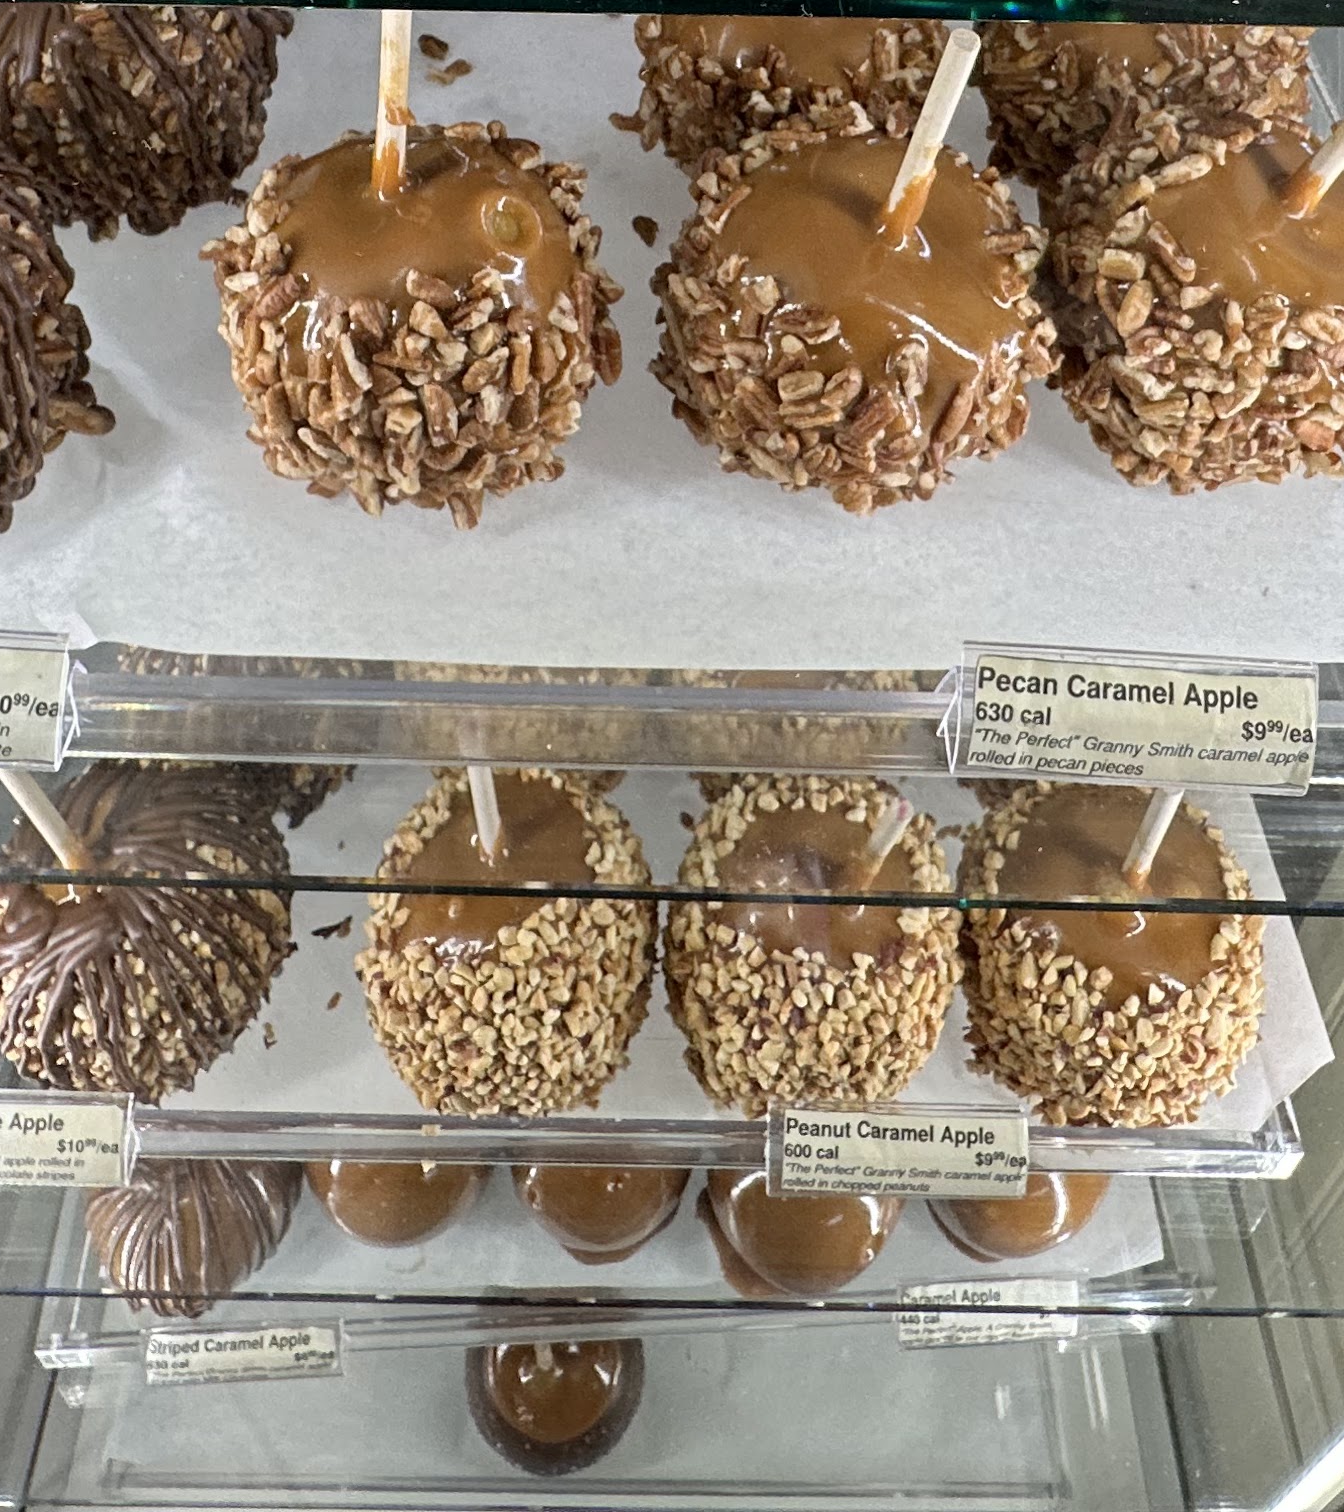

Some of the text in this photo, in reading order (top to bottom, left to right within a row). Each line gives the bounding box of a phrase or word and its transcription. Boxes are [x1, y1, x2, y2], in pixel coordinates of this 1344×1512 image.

[977, 666, 1259, 713] Pecan Caramel Apple
[975, 701, 1314, 744] 630 cal $999/ea
[974, 727, 1310, 767] "The Perfect" Granny Smith caramel apple
[969, 750, 1145, 776] rolled in pecan pieces
[8, 1113, 65, 1135] Apple
[786, 1117, 995, 1148] Peanut Caramel Apple
[5, 1156, 36, 1168] apple
[38, 1157, 71, 1168] rolled
[74, 1158, 85, 1168] in
[784, 1143, 812, 1158] 600
[816, 1145, 839, 1160] cal
[783, 1177, 930, 1193] rolled in chopped peanuts
[862, 1166, 906, 1179] Granny
[908, 1168, 942, 1180] Smith
[944, 1171, 992, 1182] caramel
[961, 1288, 1001, 1305] Apple
[149, 1332, 311, 1357] Striped Caramel Apple
